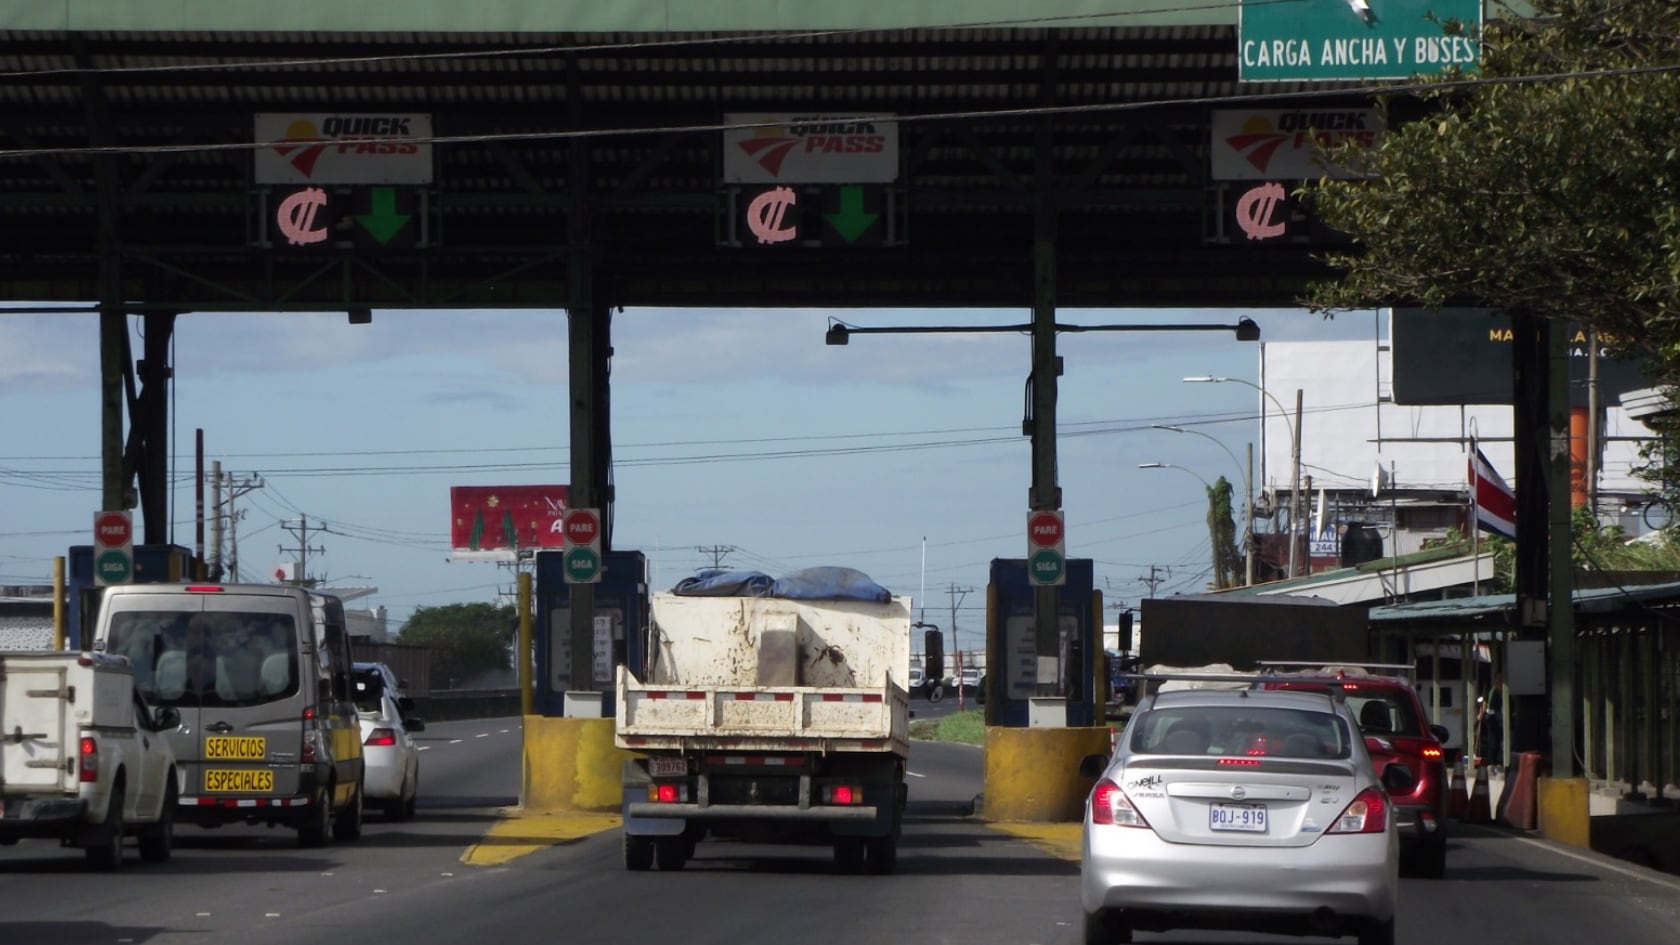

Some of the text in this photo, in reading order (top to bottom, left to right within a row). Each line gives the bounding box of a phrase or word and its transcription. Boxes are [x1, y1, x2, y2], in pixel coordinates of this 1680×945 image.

[1244, 40, 1312, 67] CARGA
[1320, 38, 1388, 65] ANCHA
[1393, 37, 1407, 64] Y
[322, 117, 412, 136] QUICK
[1278, 112, 1367, 131] QUICK
[337, 137, 419, 154] PASS
[804, 135, 886, 153] PASS
[101, 525, 126, 535] PARE
[569, 523, 593, 533] PARE
[1034, 525, 1058, 535] PARE
[103, 562, 125, 572] SIGA
[571, 559, 593, 569] SIGA
[1035, 561, 1058, 571] SIGA
[207, 738, 265, 757] SERVICIOS
[206, 771, 273, 790] ESPECIALES
